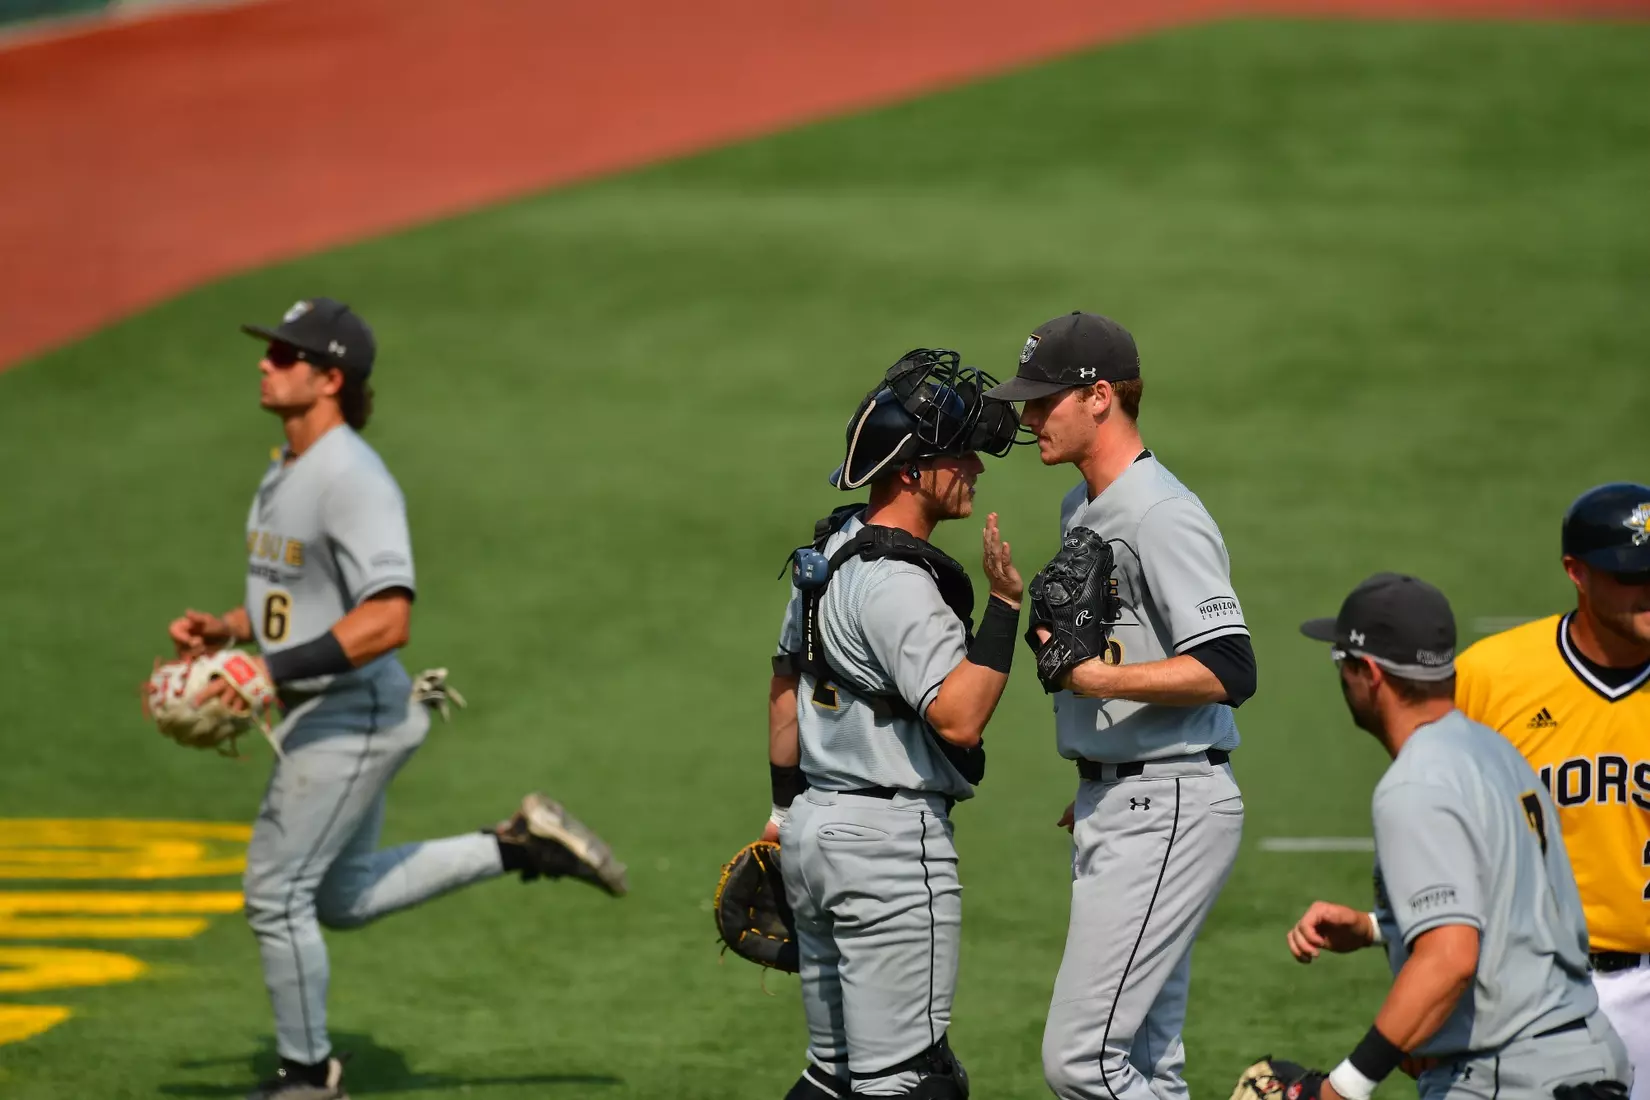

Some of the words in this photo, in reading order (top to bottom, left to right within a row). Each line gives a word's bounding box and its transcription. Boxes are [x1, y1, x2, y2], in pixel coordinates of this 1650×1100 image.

[263, 590, 293, 645] 6
[1199, 602, 1237, 615] HORIZON
[1540, 754, 1650, 811] ORS
[1520, 790, 1547, 858] 7
